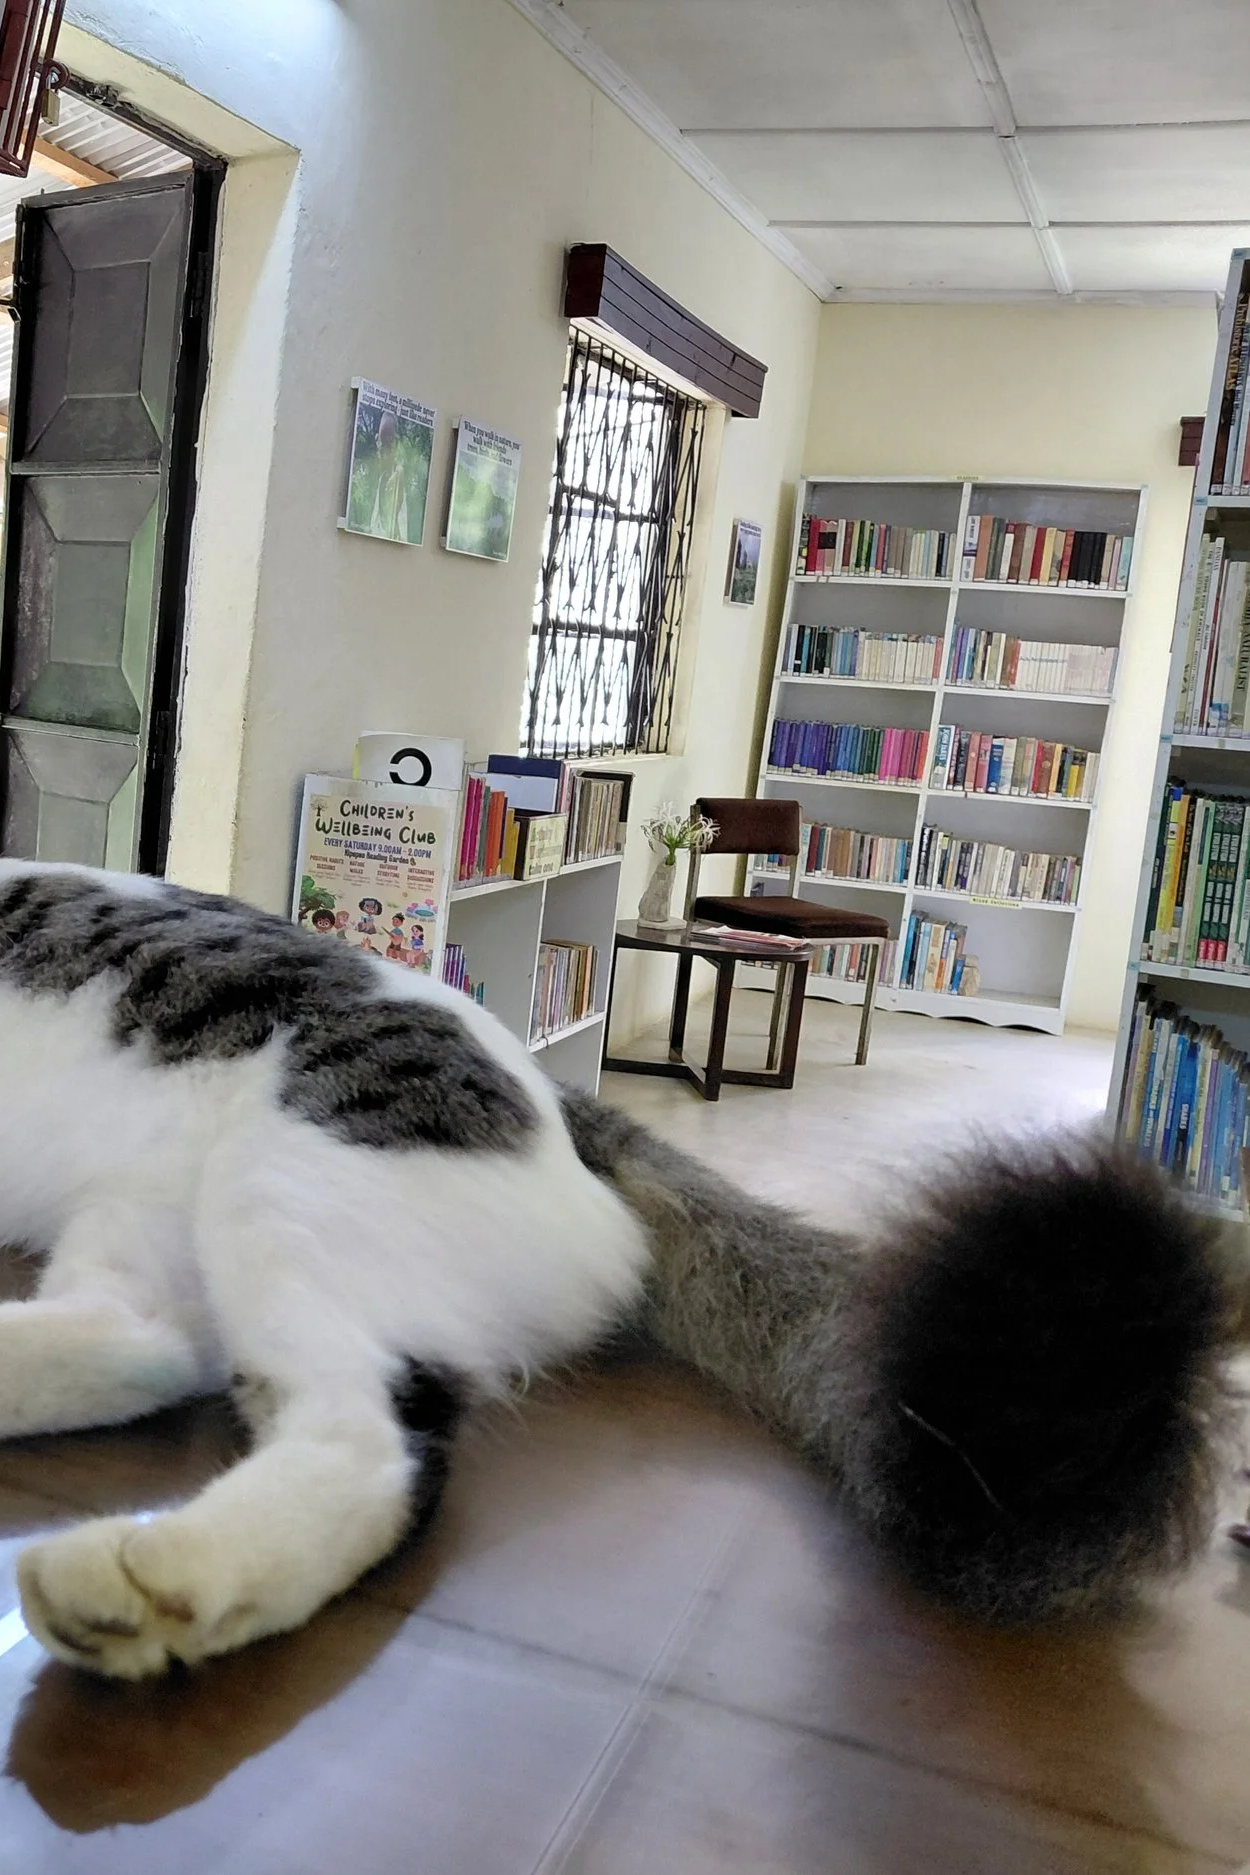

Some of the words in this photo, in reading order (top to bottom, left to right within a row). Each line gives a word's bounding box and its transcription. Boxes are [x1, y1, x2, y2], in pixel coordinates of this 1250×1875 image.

[1226, 356, 1239, 390] ATLAS
[324, 838, 343, 848] EVERY
[344, 840, 377, 852] SATURDAY
[1211, 832, 1221, 860] EVOLUTION
[1220, 833, 1231, 862] EVOLUTION
[1229, 834, 1240, 863] EVOLUTION
[1180, 1104, 1189, 1130] SHARKS
